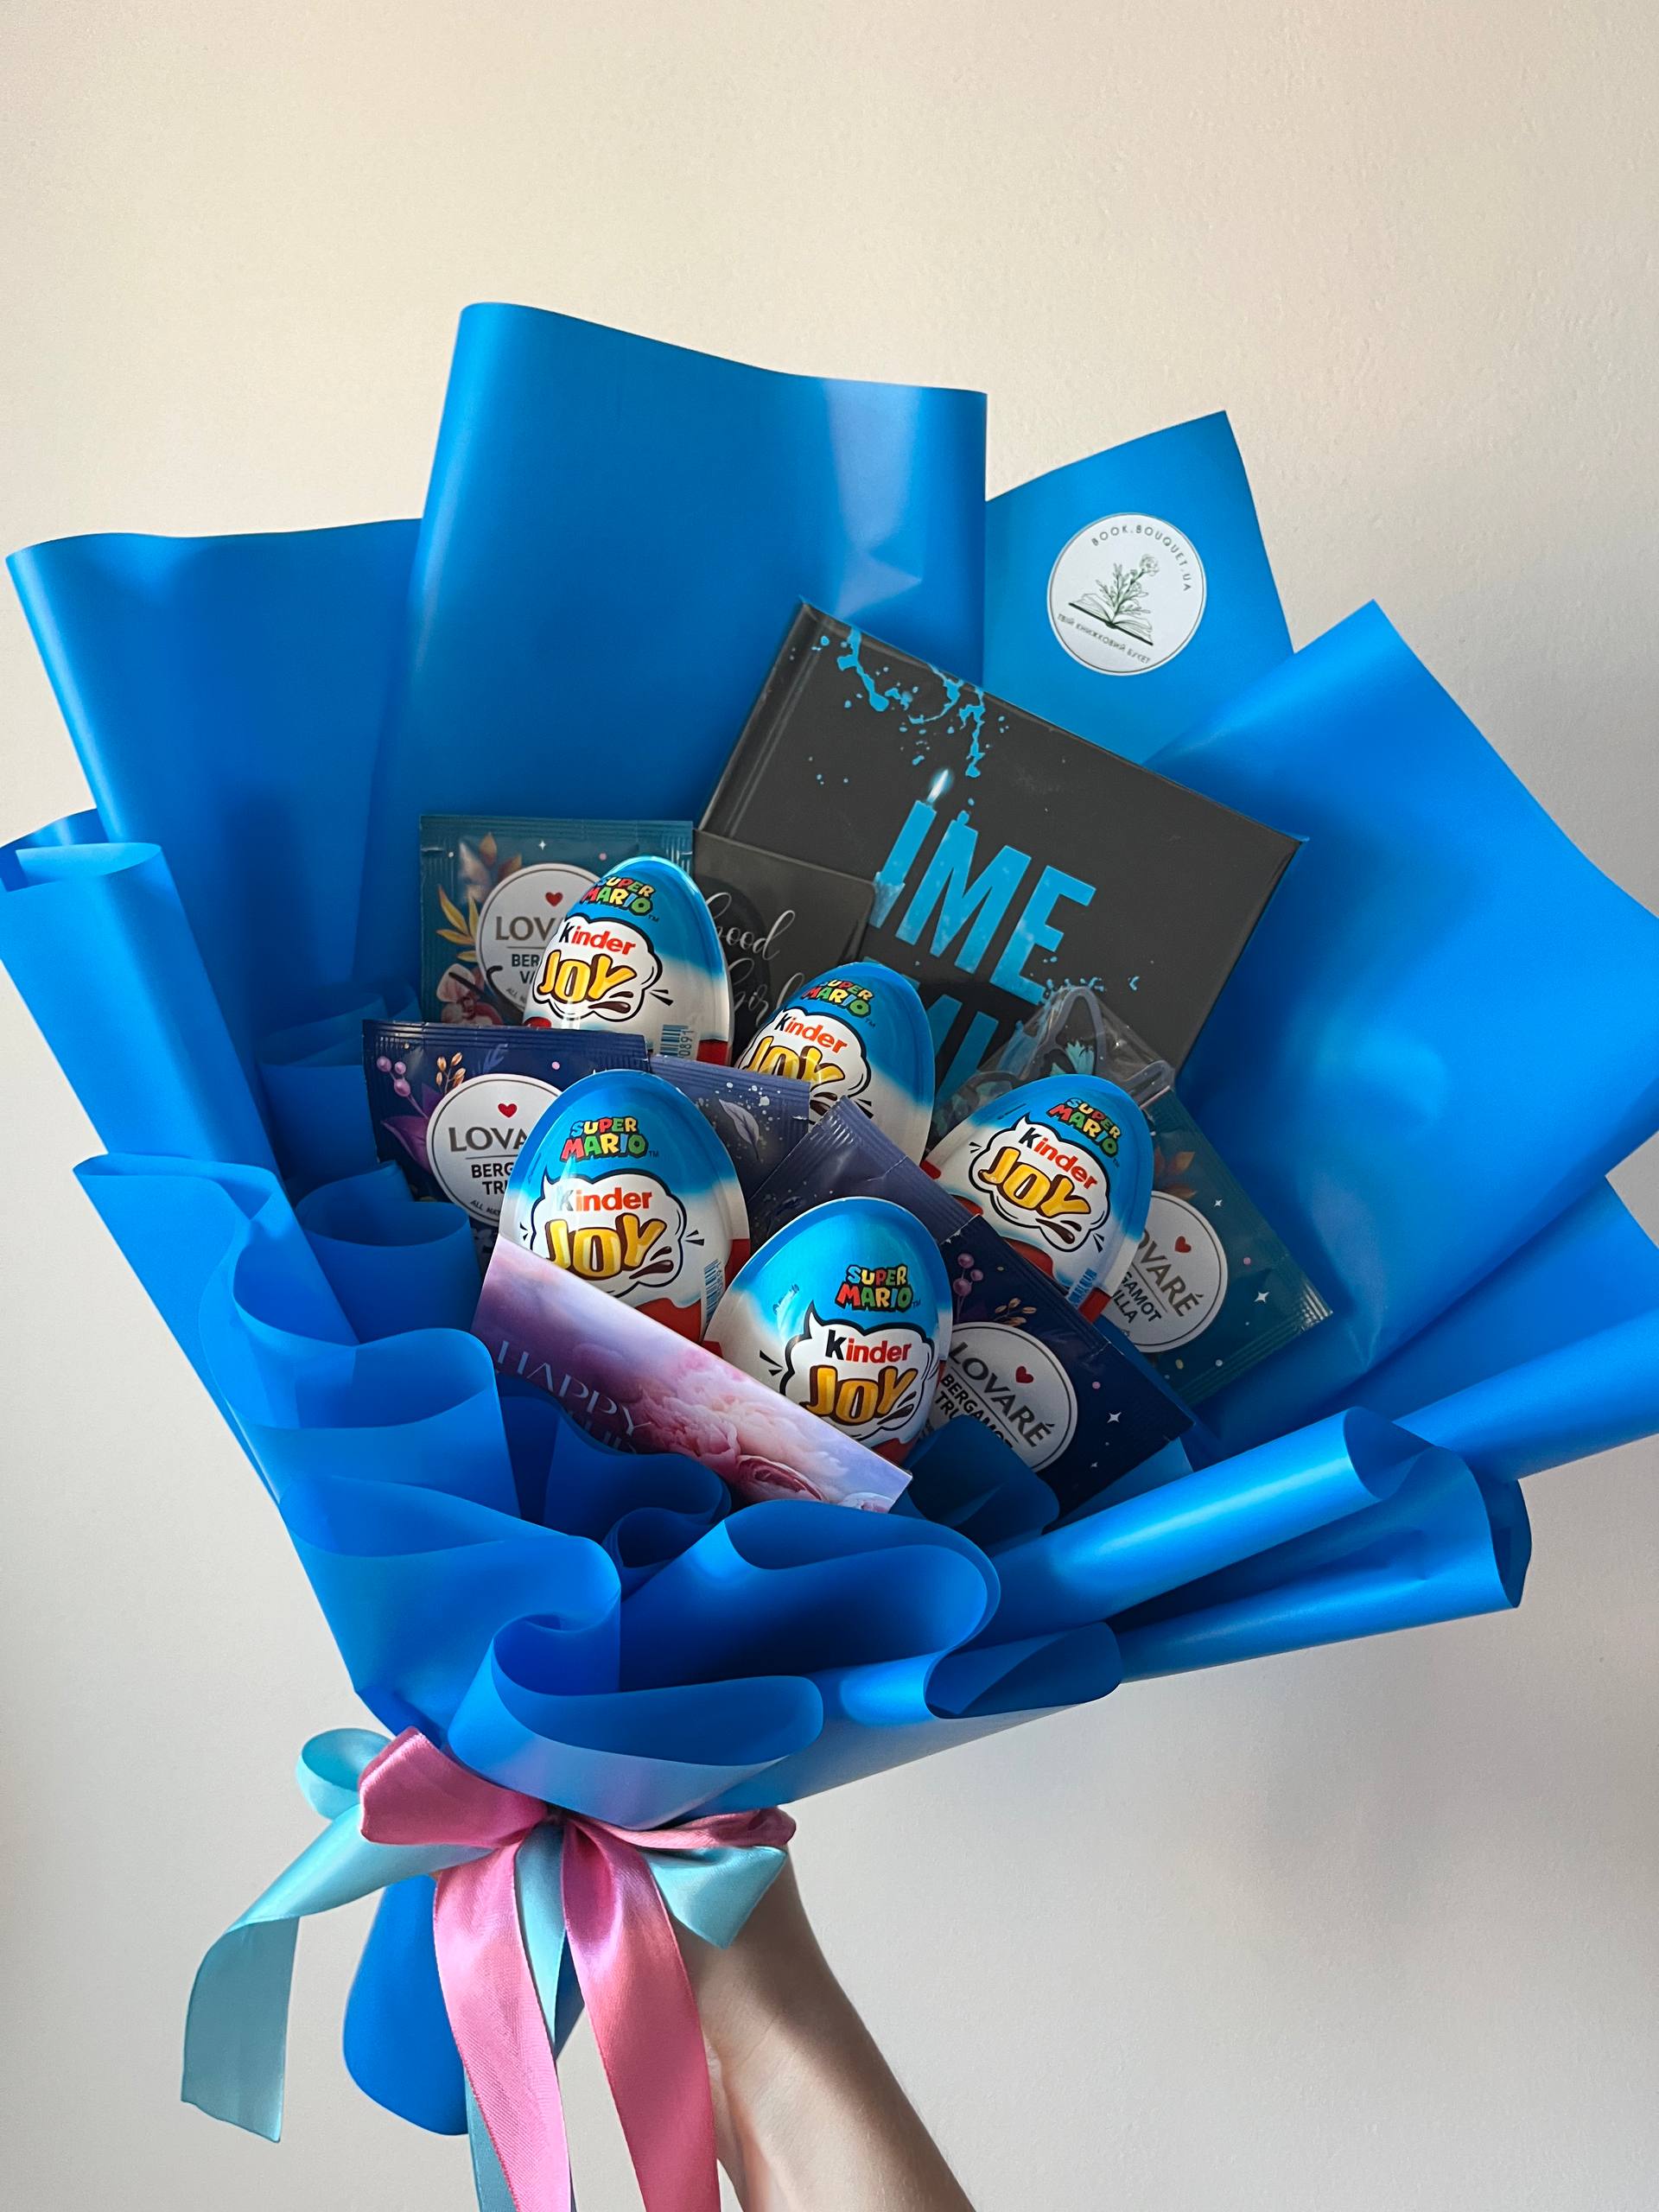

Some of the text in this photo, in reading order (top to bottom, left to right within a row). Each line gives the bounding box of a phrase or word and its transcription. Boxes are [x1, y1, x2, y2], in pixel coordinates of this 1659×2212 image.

[580, 887, 653, 916] MARIO
[495, 916, 556, 941] LOV
[559, 922, 636, 956] Kinder
[536, 950, 638, 1004] JOY
[802, 987, 871, 1017] MARIO
[774, 1013, 849, 1054] Kinder
[569, 1116, 639, 1138] SUPER
[1046, 1103, 1119, 1158] MARIO
[1066, 1097, 1121, 1140] SUPER
[560, 1132, 649, 1163] MARIO
[1019, 1127, 1097, 1190] Kinder
[560, 1187, 652, 1212] Kinder
[977, 1147, 1091, 1218] JOY
[544, 1212, 667, 1281] JOY
[845, 1263, 908, 1286] SUPER
[835, 1281, 913, 1313] MARIO
[825, 1329, 912, 1363] Kinder
[498, 1340, 652, 1436] HAPPY
[799, 1364, 918, 1425] JOY
[949, 1342, 1055, 1447] LOVARÉ
